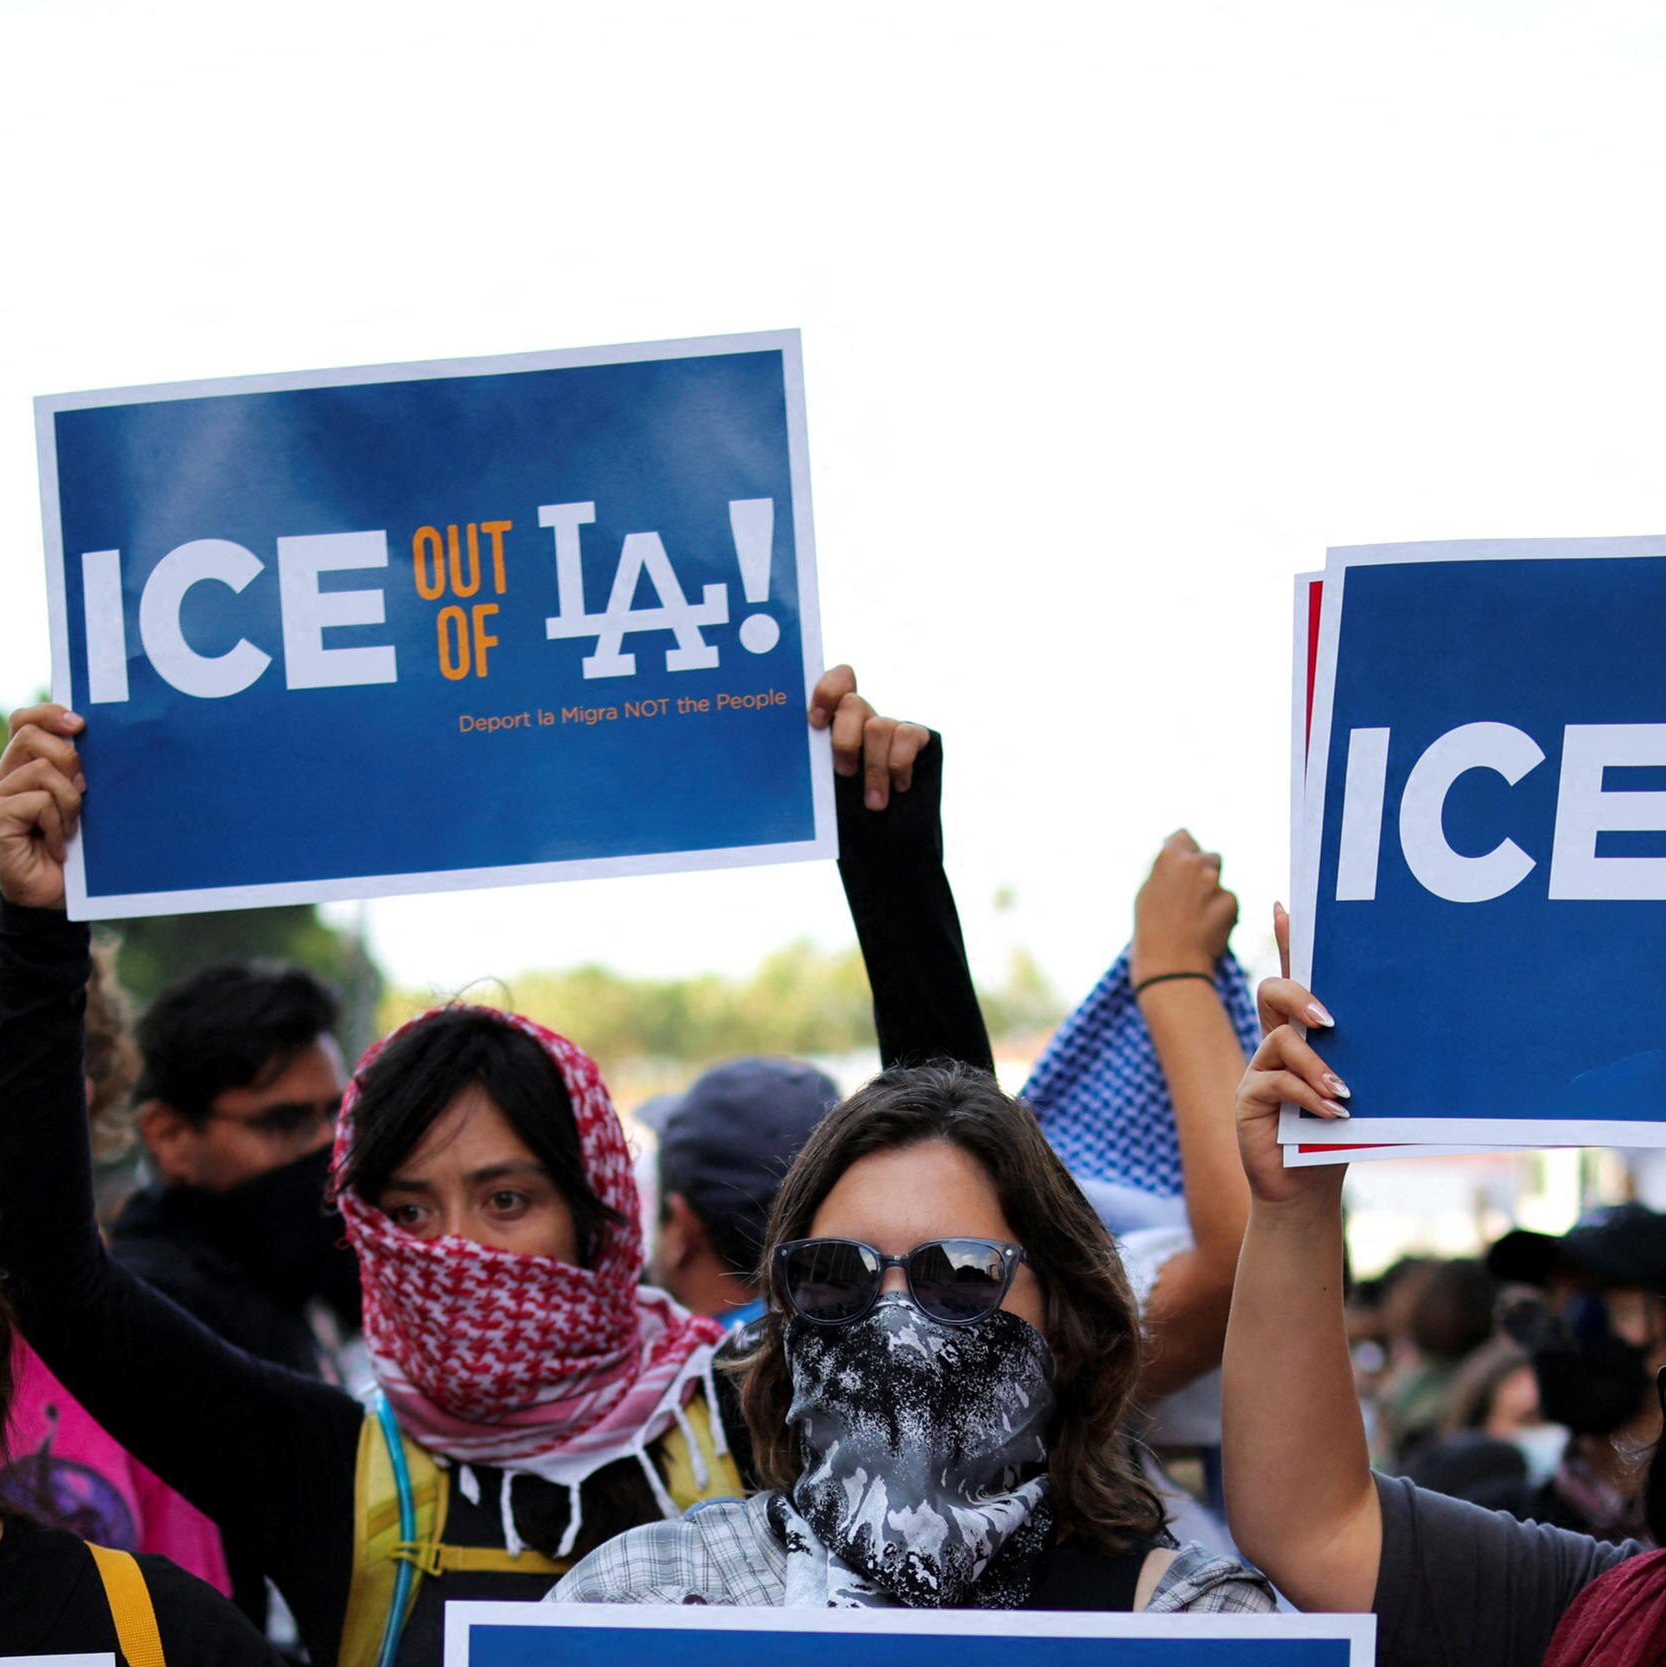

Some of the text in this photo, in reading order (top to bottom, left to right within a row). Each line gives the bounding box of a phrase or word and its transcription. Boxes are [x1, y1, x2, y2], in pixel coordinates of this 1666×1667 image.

[412, 520, 514, 601] OUT
[81, 529, 399, 704] ICE
[436, 602, 501, 681] OF
[459, 688, 788, 733] Deport la Migra NOT the People
